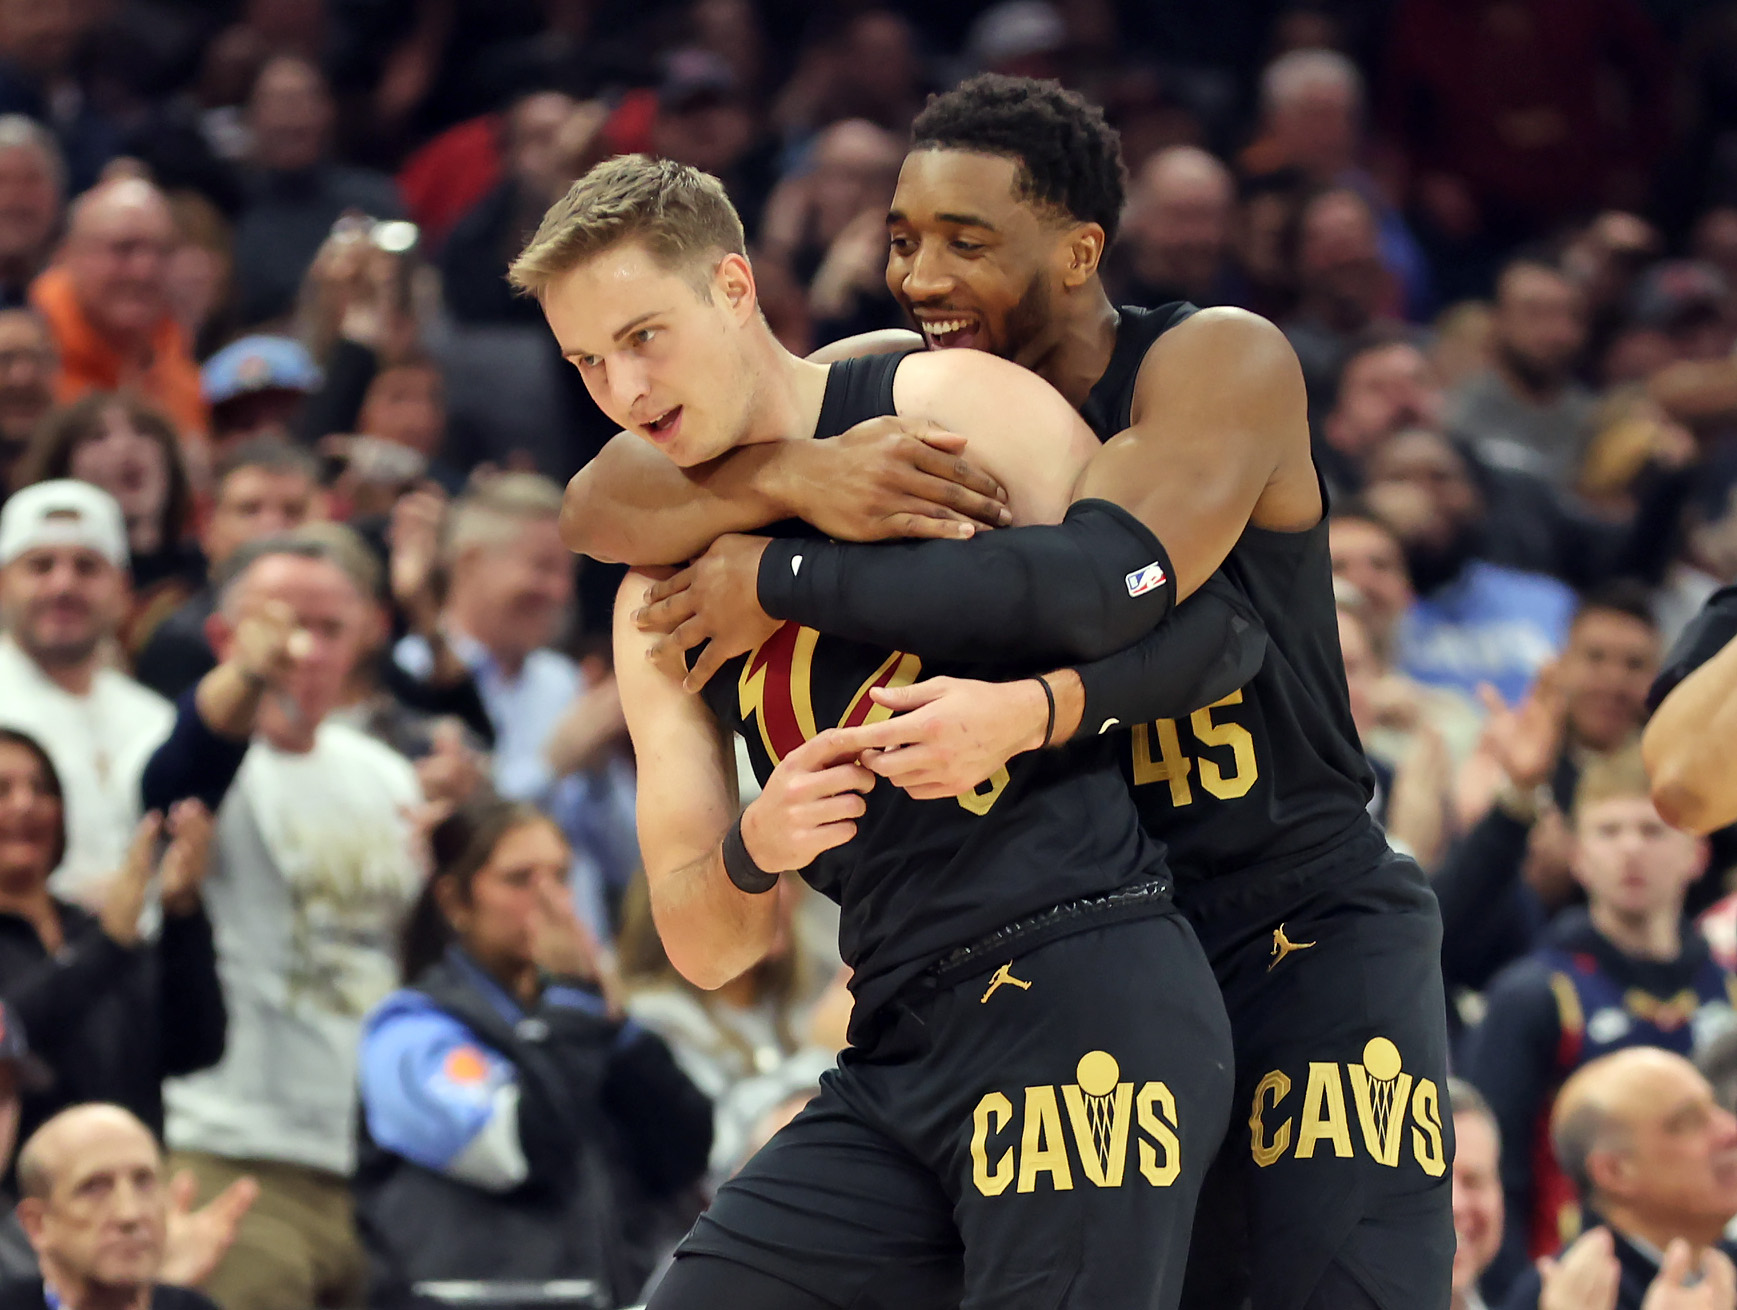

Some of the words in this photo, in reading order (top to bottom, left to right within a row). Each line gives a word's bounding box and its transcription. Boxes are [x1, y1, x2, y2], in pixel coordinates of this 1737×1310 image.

[1131, 688, 1259, 807] 45
[970, 1051, 1182, 1197] CAVS
[1250, 1038, 1446, 1178] CAVS
